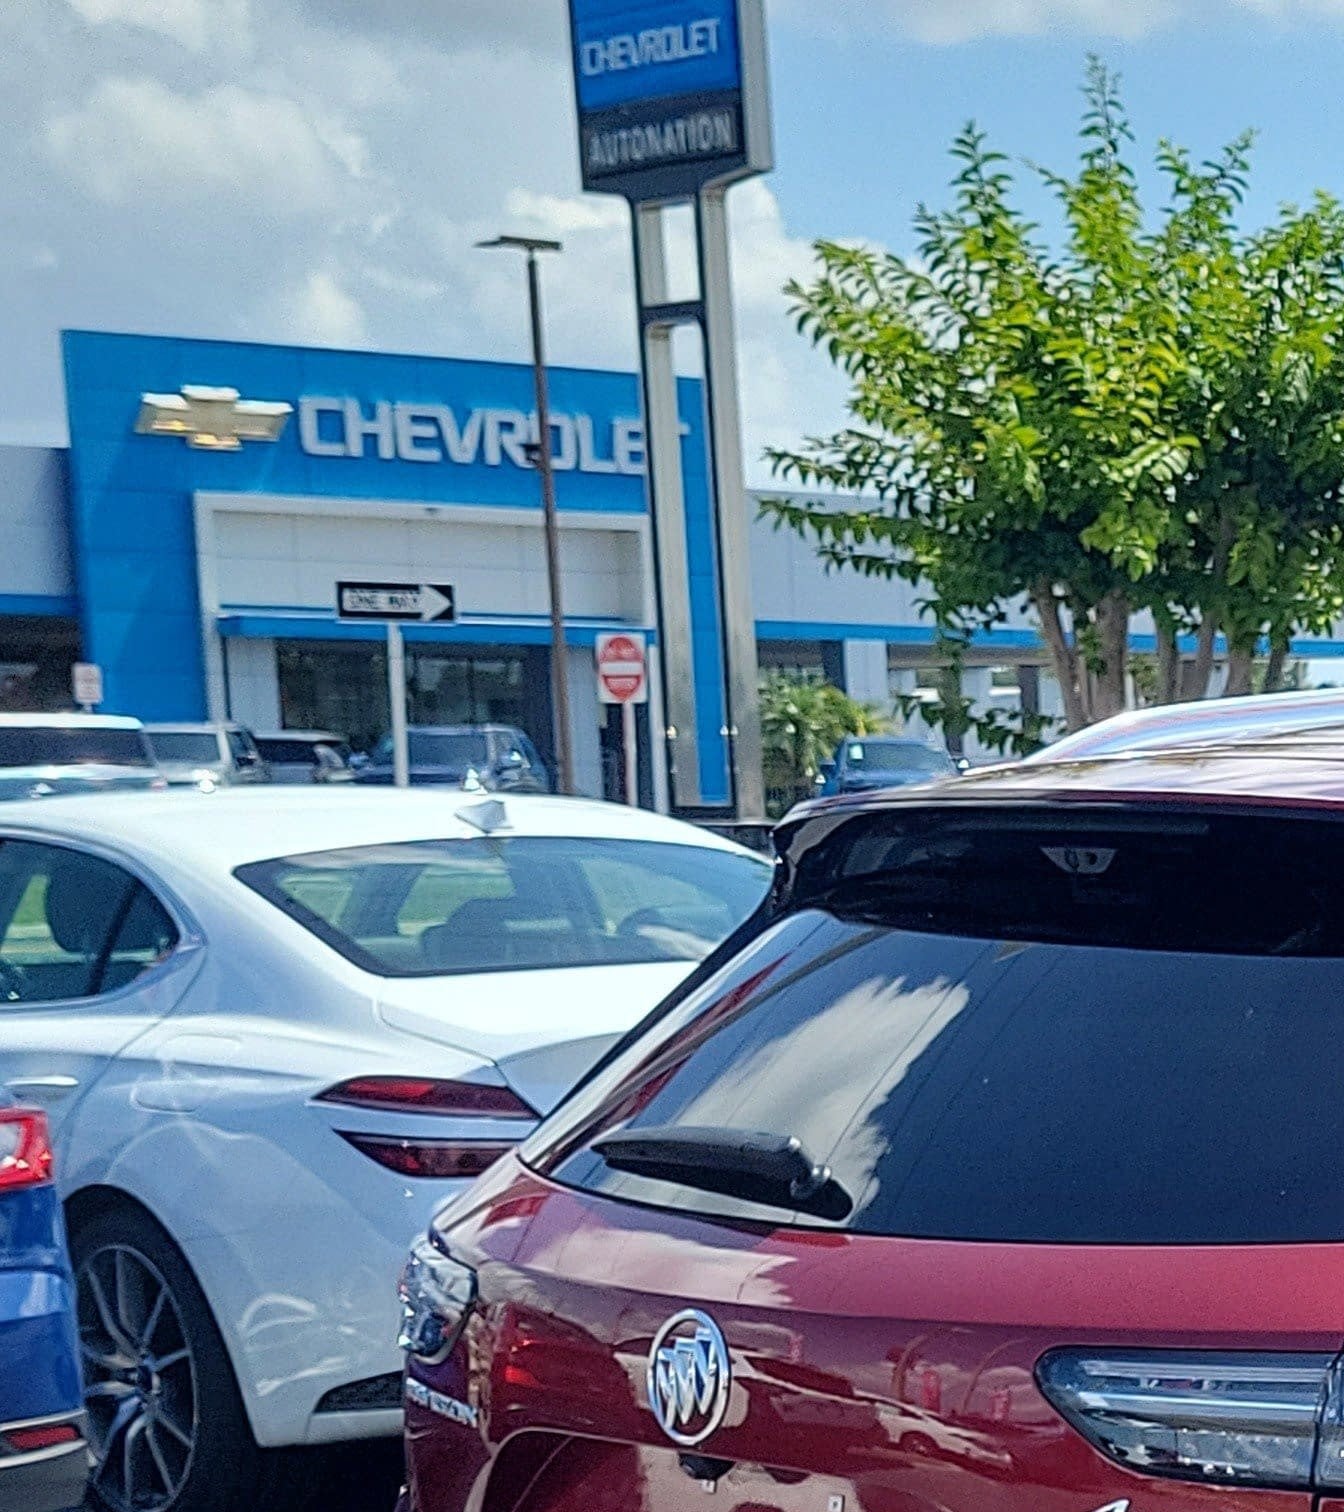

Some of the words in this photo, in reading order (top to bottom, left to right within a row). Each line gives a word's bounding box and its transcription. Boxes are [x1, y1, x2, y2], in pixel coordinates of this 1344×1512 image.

[580, 18, 721, 76] CHEVROLET
[588, 113, 734, 167] AUTONATION
[299, 395, 691, 475] CHEVROLE
